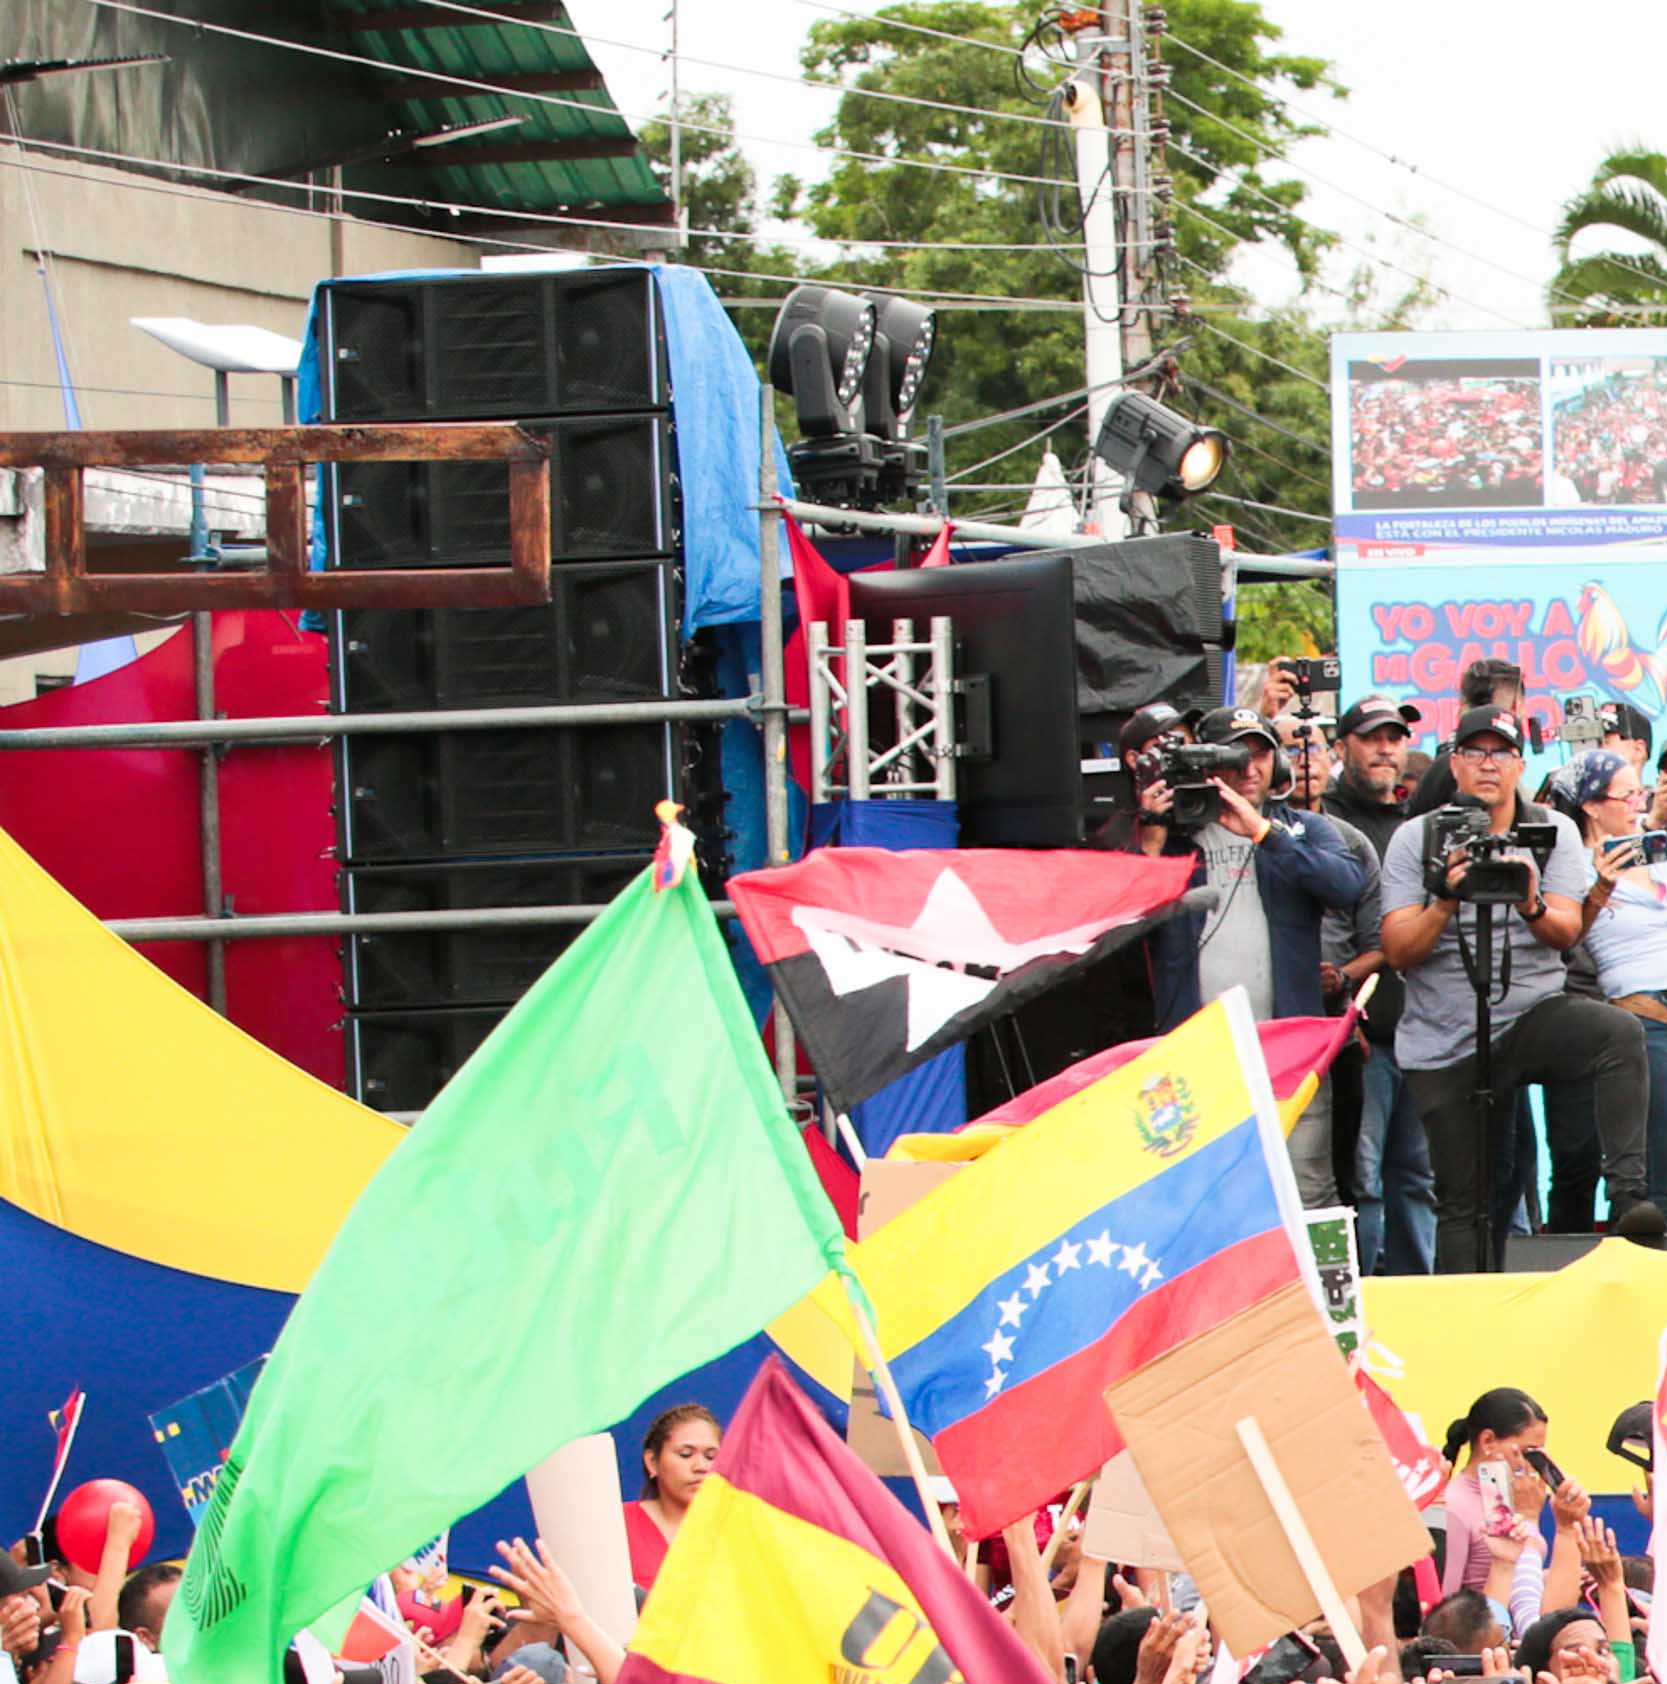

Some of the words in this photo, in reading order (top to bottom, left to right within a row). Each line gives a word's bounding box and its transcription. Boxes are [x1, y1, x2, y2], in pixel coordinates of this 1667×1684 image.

[1373, 603, 1435, 641] YO
[1445, 602, 1533, 639] VOY
[1542, 601, 1574, 637] A
